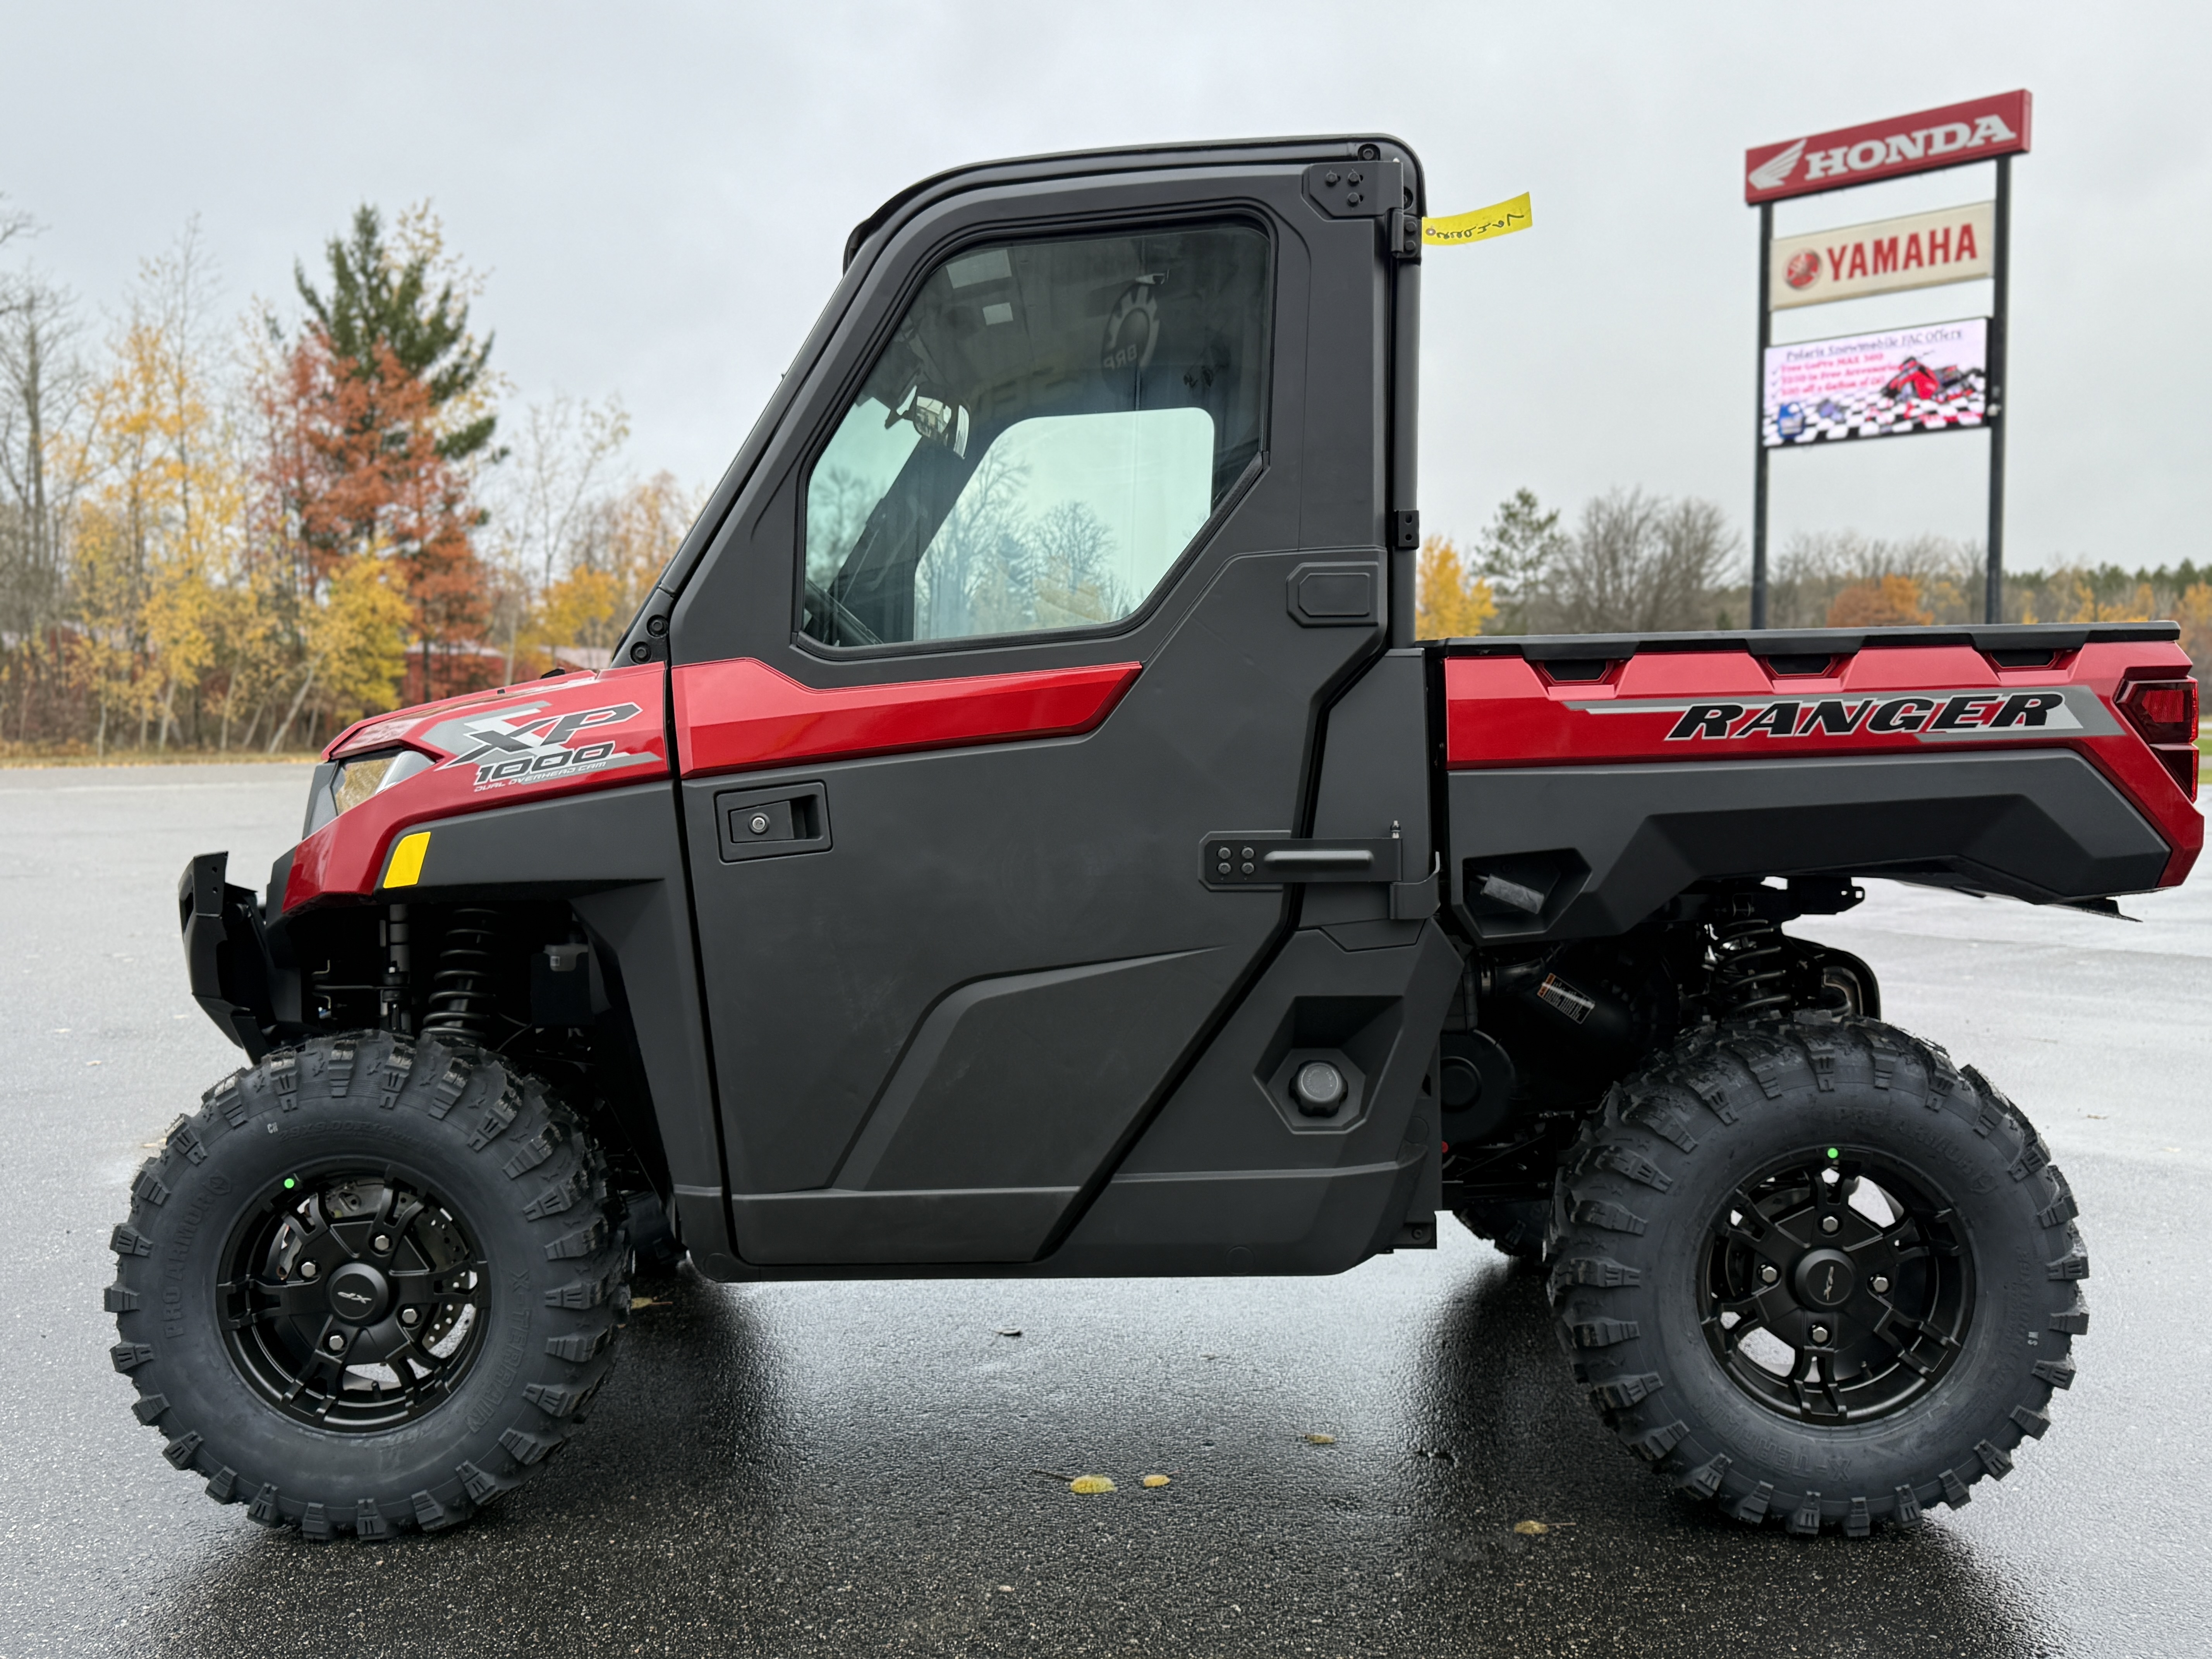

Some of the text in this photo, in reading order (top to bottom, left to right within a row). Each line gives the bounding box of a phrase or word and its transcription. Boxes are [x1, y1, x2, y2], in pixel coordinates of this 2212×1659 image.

[1805, 114, 2016, 180] HONDA
[1826, 223, 1978, 282] YAMAHA
[435, 701, 644, 771] XP
[1664, 691, 2066, 741] RANGER
[473, 740, 616, 786] 1000
[474, 761, 606, 792] DUAL OVERHEAD CAM
[160, 1195, 215, 1339] PRO ARMOR
[465, 1269, 531, 1434] X-TERRAIN
[1692, 1391, 1851, 1482] X-TERRAIN
